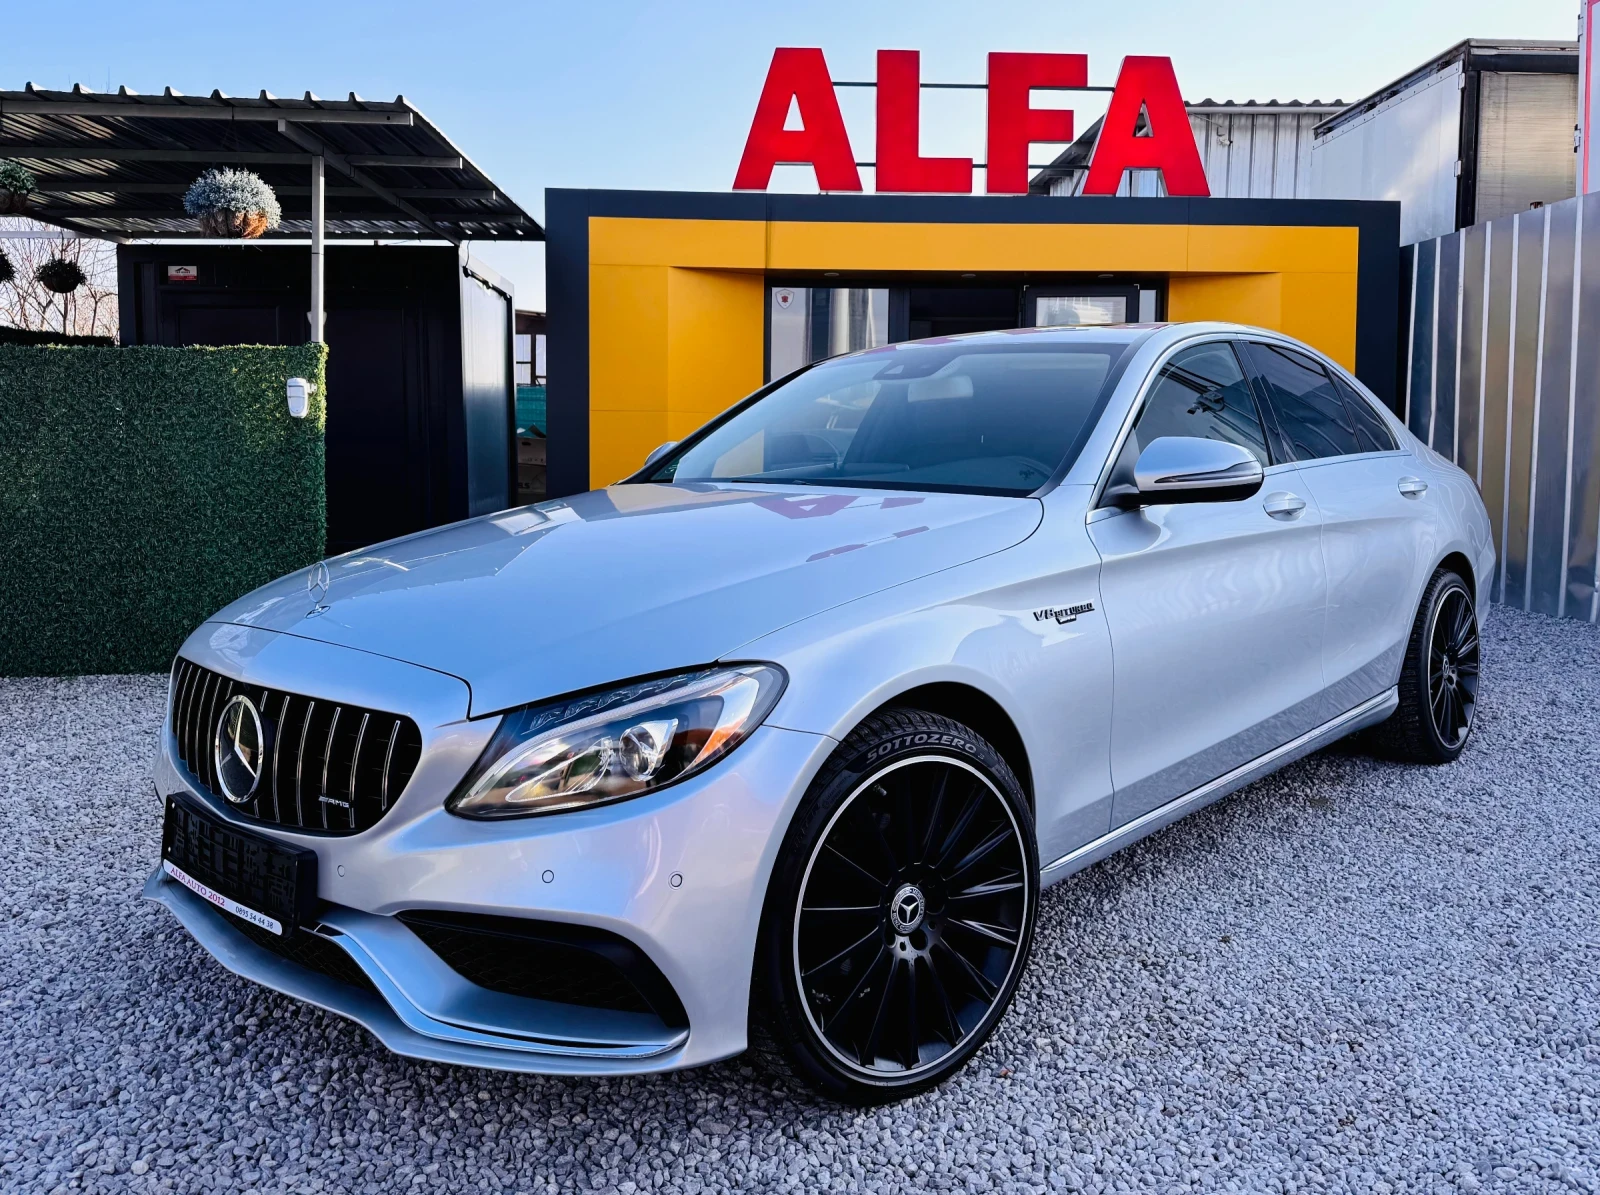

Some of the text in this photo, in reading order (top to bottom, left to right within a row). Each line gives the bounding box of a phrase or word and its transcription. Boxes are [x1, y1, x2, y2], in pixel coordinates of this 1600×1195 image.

[732, 47, 1210, 197] ALFA
[866, 733, 977, 764] SOTTOZERO
[328, 798, 349, 808] AMG
[171, 867, 186, 883] ALFA
[187, 878, 207, 896] AUTO
[208, 892, 225, 906] 2012
[235, 905, 248, 917] 0895
[249, 911, 257, 921] 54
[266, 921, 273, 929] 38
